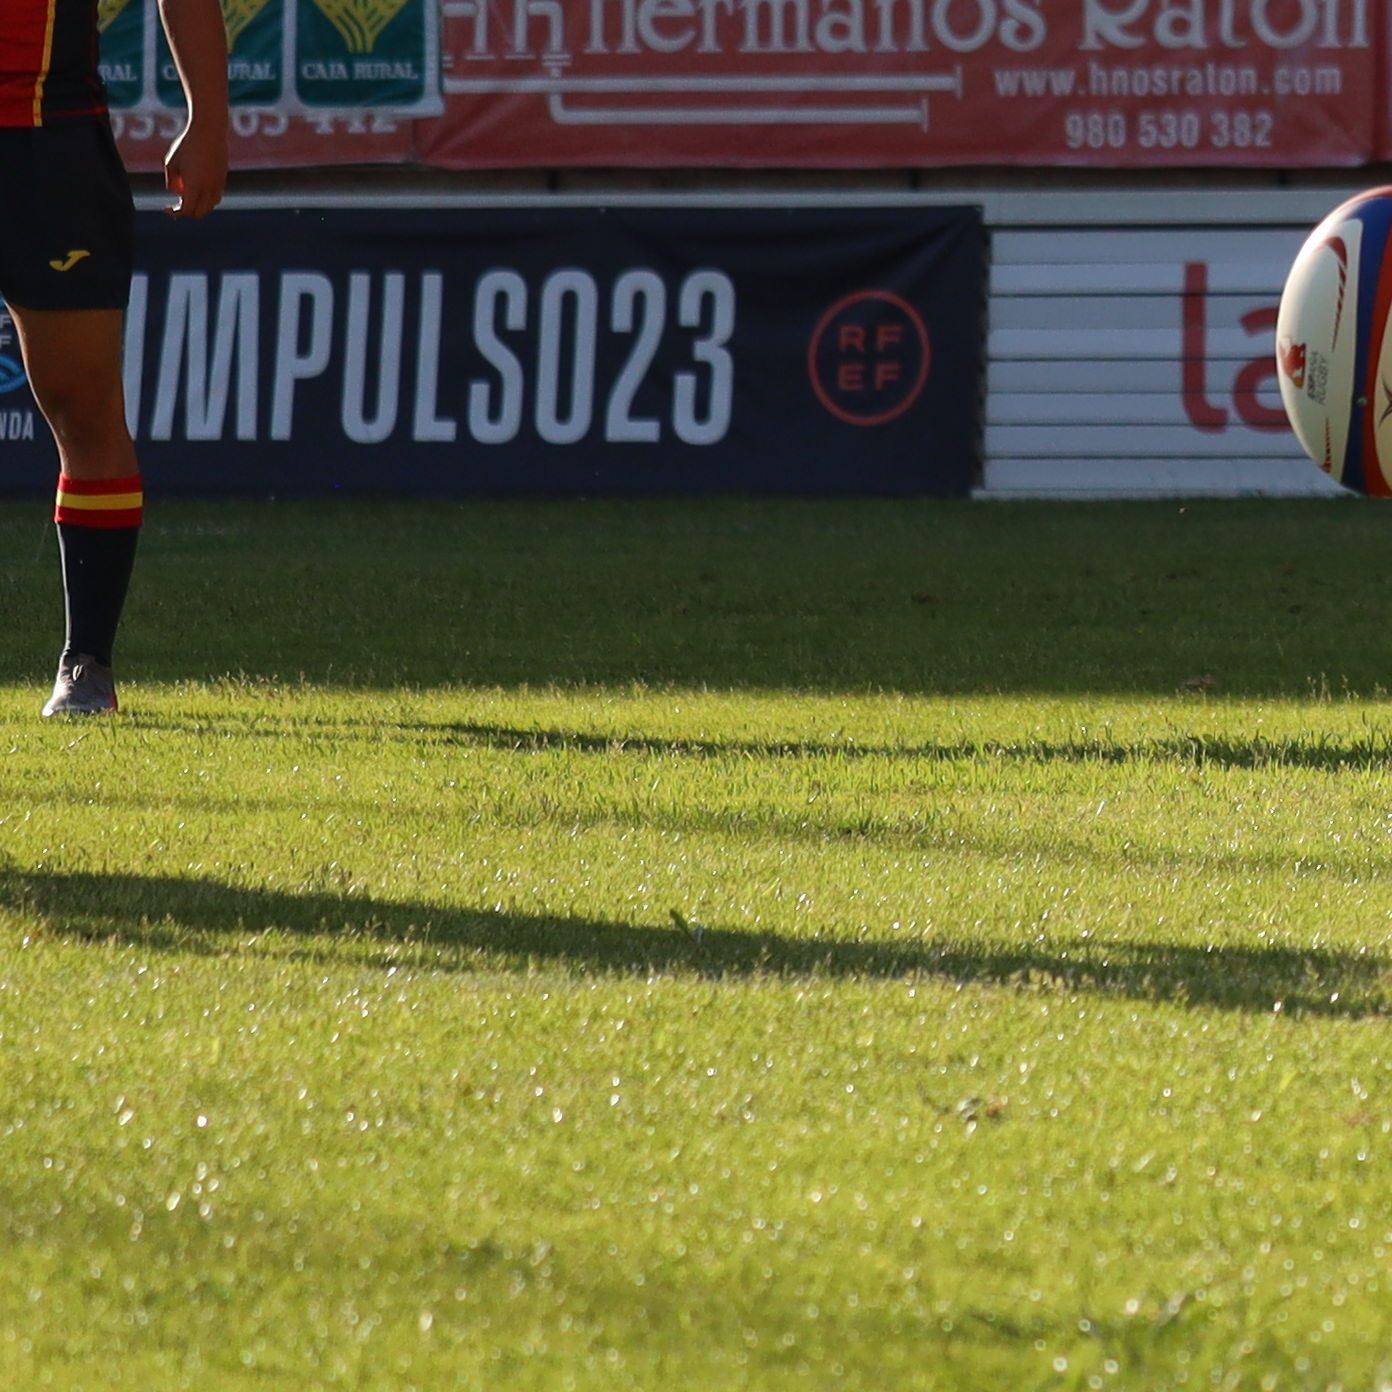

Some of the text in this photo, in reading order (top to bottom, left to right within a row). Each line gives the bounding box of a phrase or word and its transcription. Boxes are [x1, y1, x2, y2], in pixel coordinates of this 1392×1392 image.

[353, 61, 419, 81] RURAL
[994, 62, 1343, 98] www.hnosraton.com
[1065, 111, 1273, 149] 980 530 382
